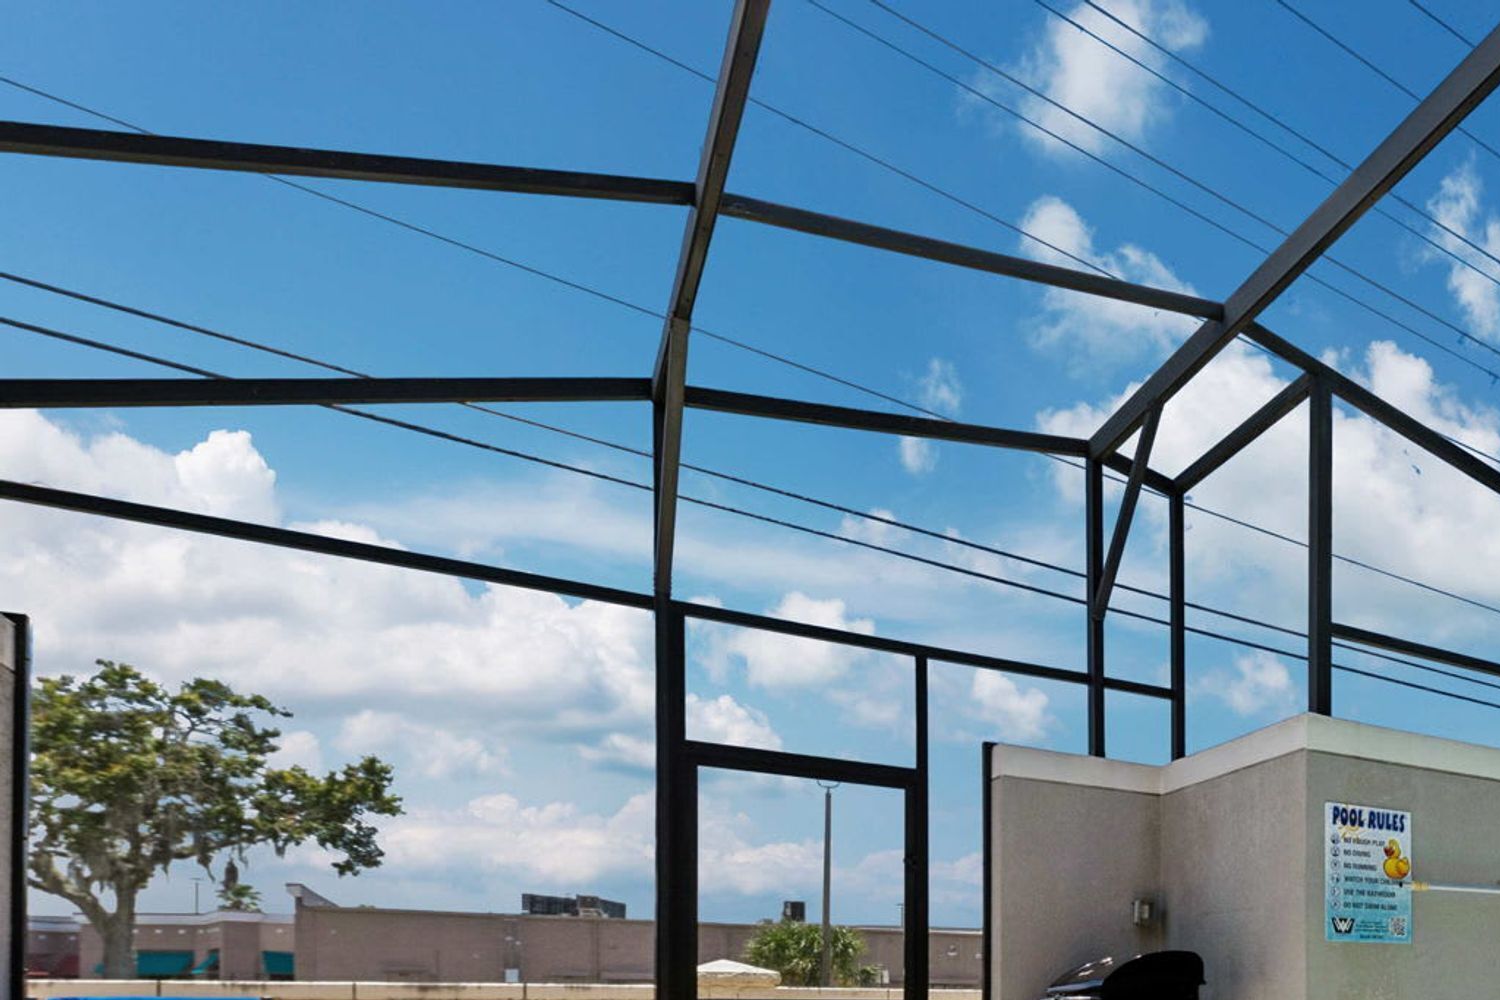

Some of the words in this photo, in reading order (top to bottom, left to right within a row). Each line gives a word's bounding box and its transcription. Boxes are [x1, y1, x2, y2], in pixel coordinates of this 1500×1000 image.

[1332, 806, 1364, 827] POOL
[1368, 810, 1405, 832] RULES
[1352, 863, 1376, 871] RUNNING
